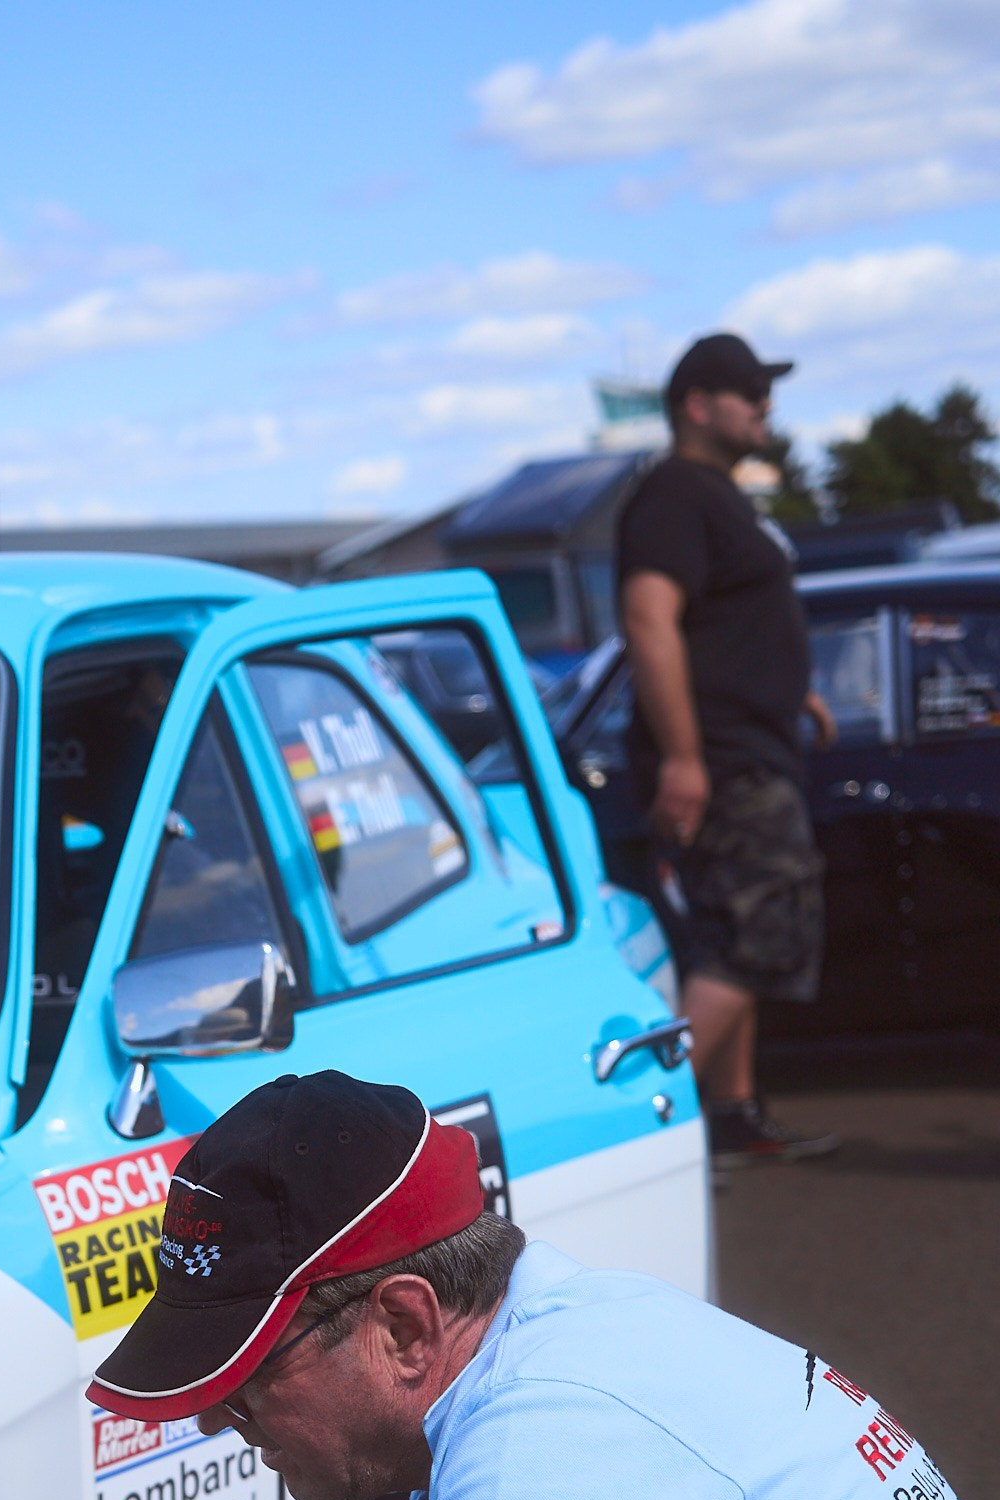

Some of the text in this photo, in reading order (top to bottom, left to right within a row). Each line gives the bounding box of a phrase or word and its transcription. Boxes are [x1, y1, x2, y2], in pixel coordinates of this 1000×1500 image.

[35, 1152, 172, 1232] BOSCH
[58, 1215, 162, 1267] RACIN
[67, 1244, 158, 1315] TEA
[96, 1427, 159, 1466] Mirror
